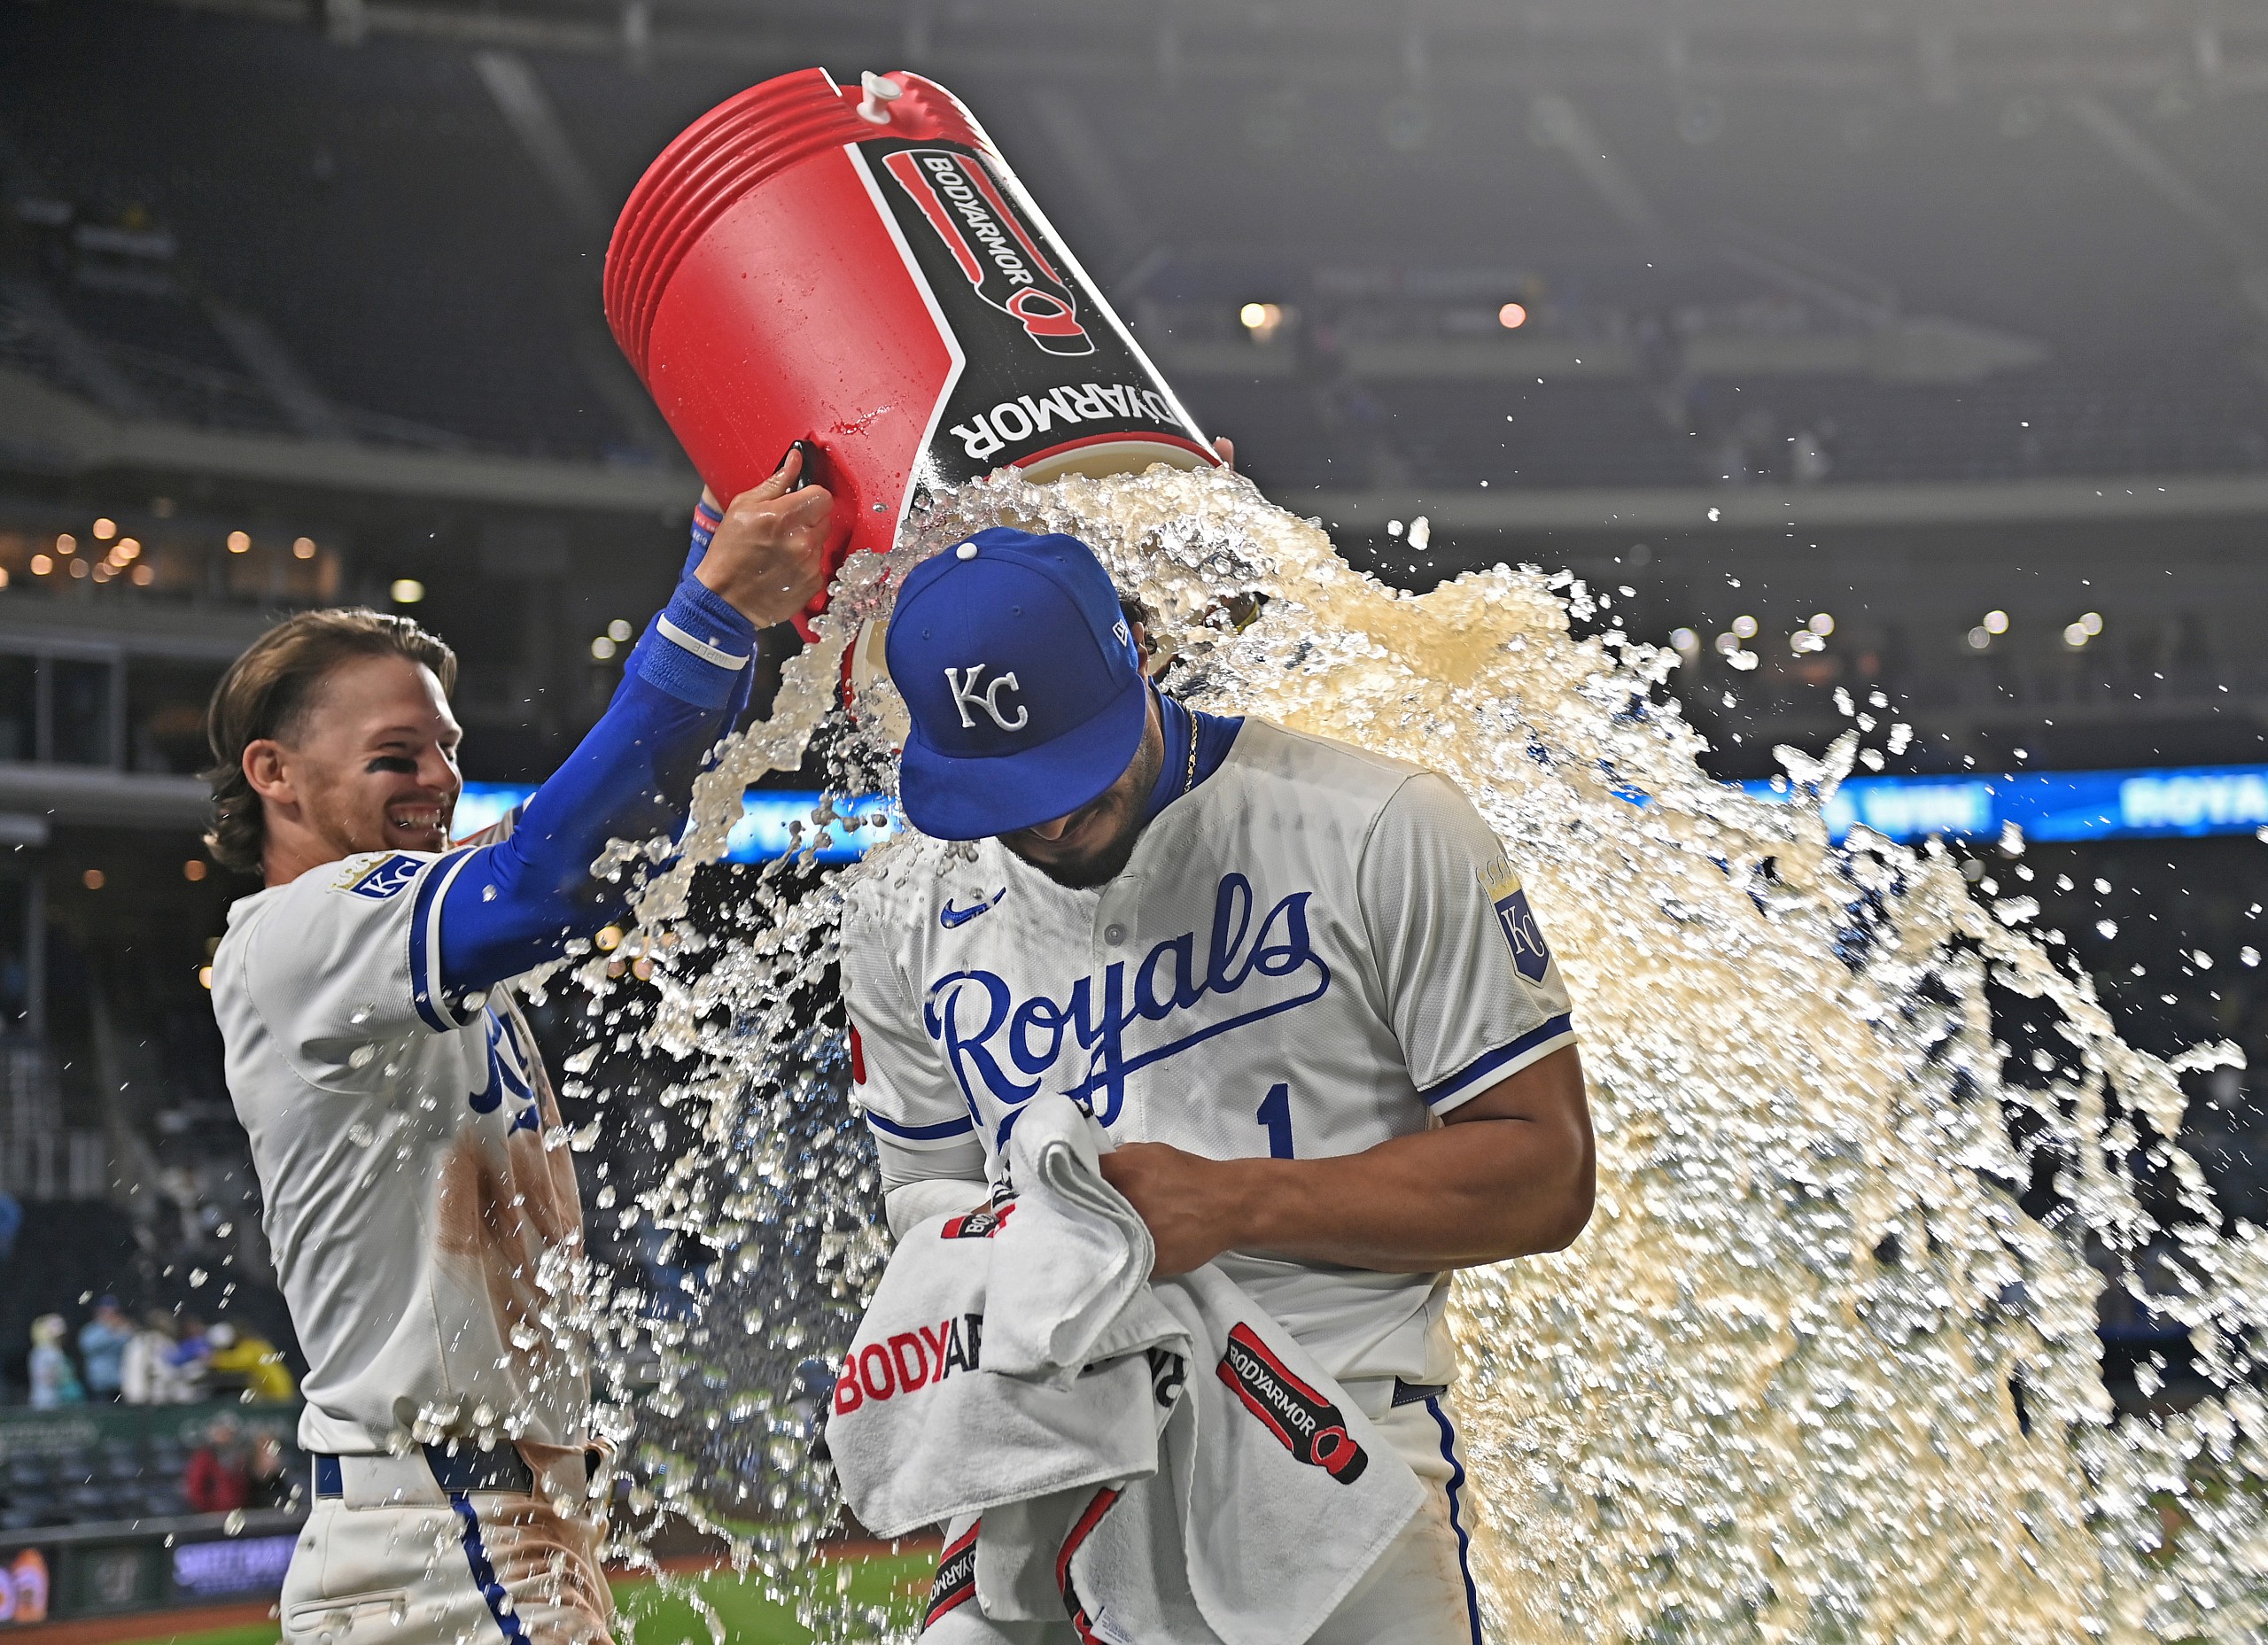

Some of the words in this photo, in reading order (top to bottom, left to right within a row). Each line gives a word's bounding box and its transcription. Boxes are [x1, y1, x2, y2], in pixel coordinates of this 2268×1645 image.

[923, 157, 1035, 285] BODYARMOR
[944, 663, 1028, 732] KC
[359, 861, 416, 896] KC
[1501, 905, 1545, 958] KC
[924, 873, 1330, 1143] Royals
[1256, 1082, 1294, 1160] 1
[1230, 1344, 1317, 1438] BODYARMOR
